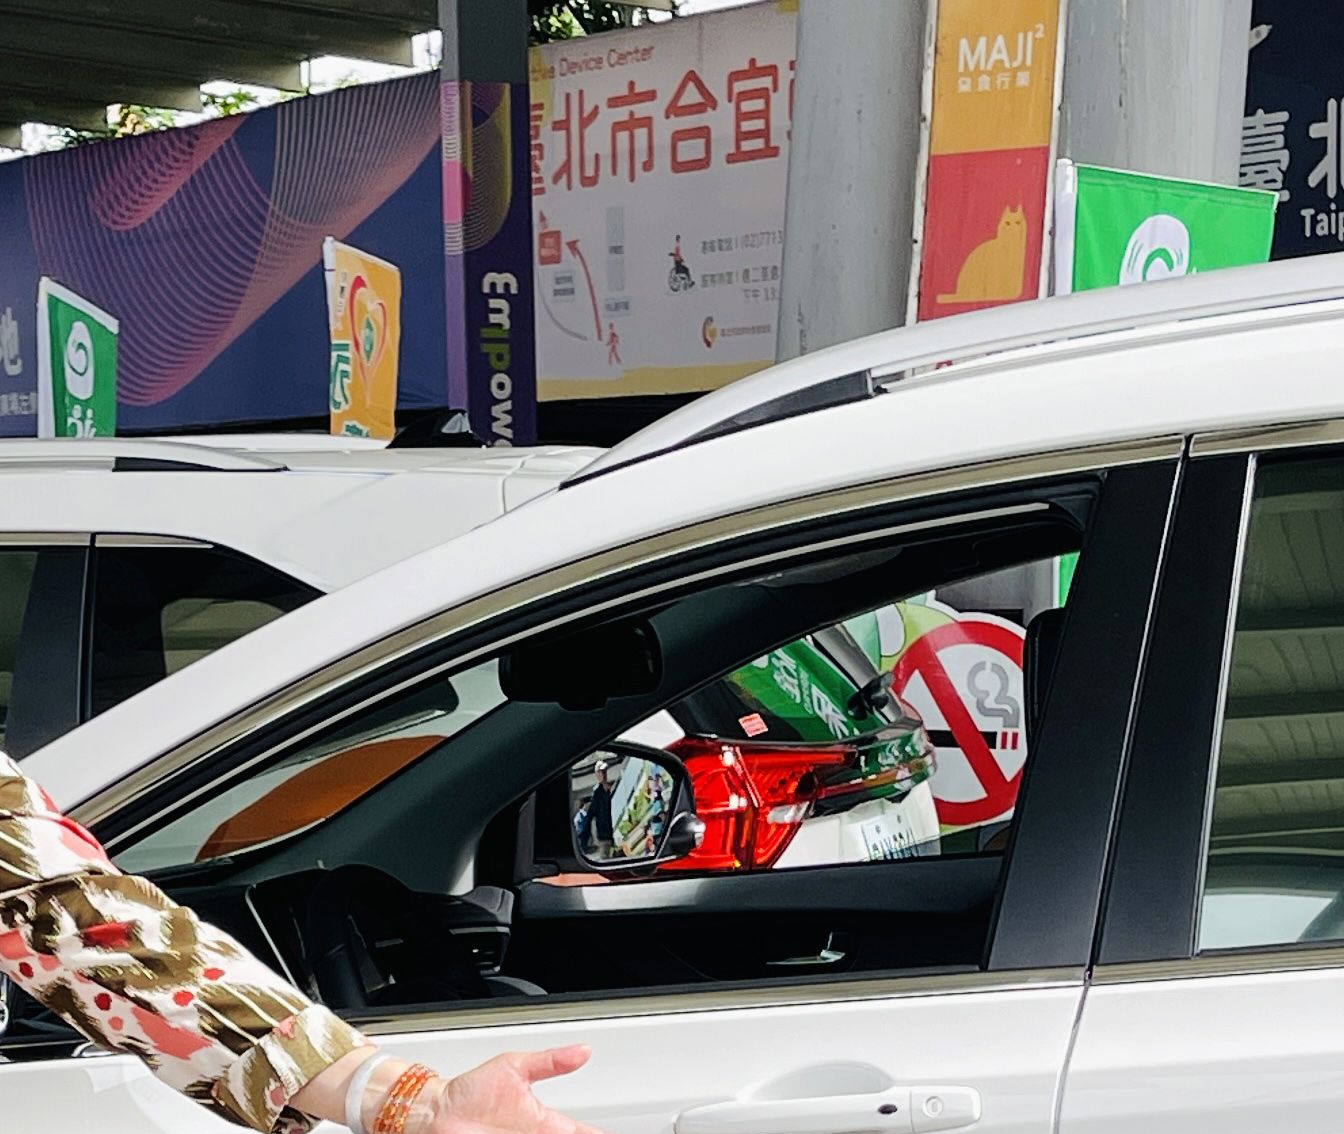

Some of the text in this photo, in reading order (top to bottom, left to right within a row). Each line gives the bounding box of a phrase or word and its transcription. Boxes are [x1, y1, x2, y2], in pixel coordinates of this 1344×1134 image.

[560, 52, 604, 77] Device
[607, 46, 655, 69] Center
[530, 58, 795, 196] 北市合宜
